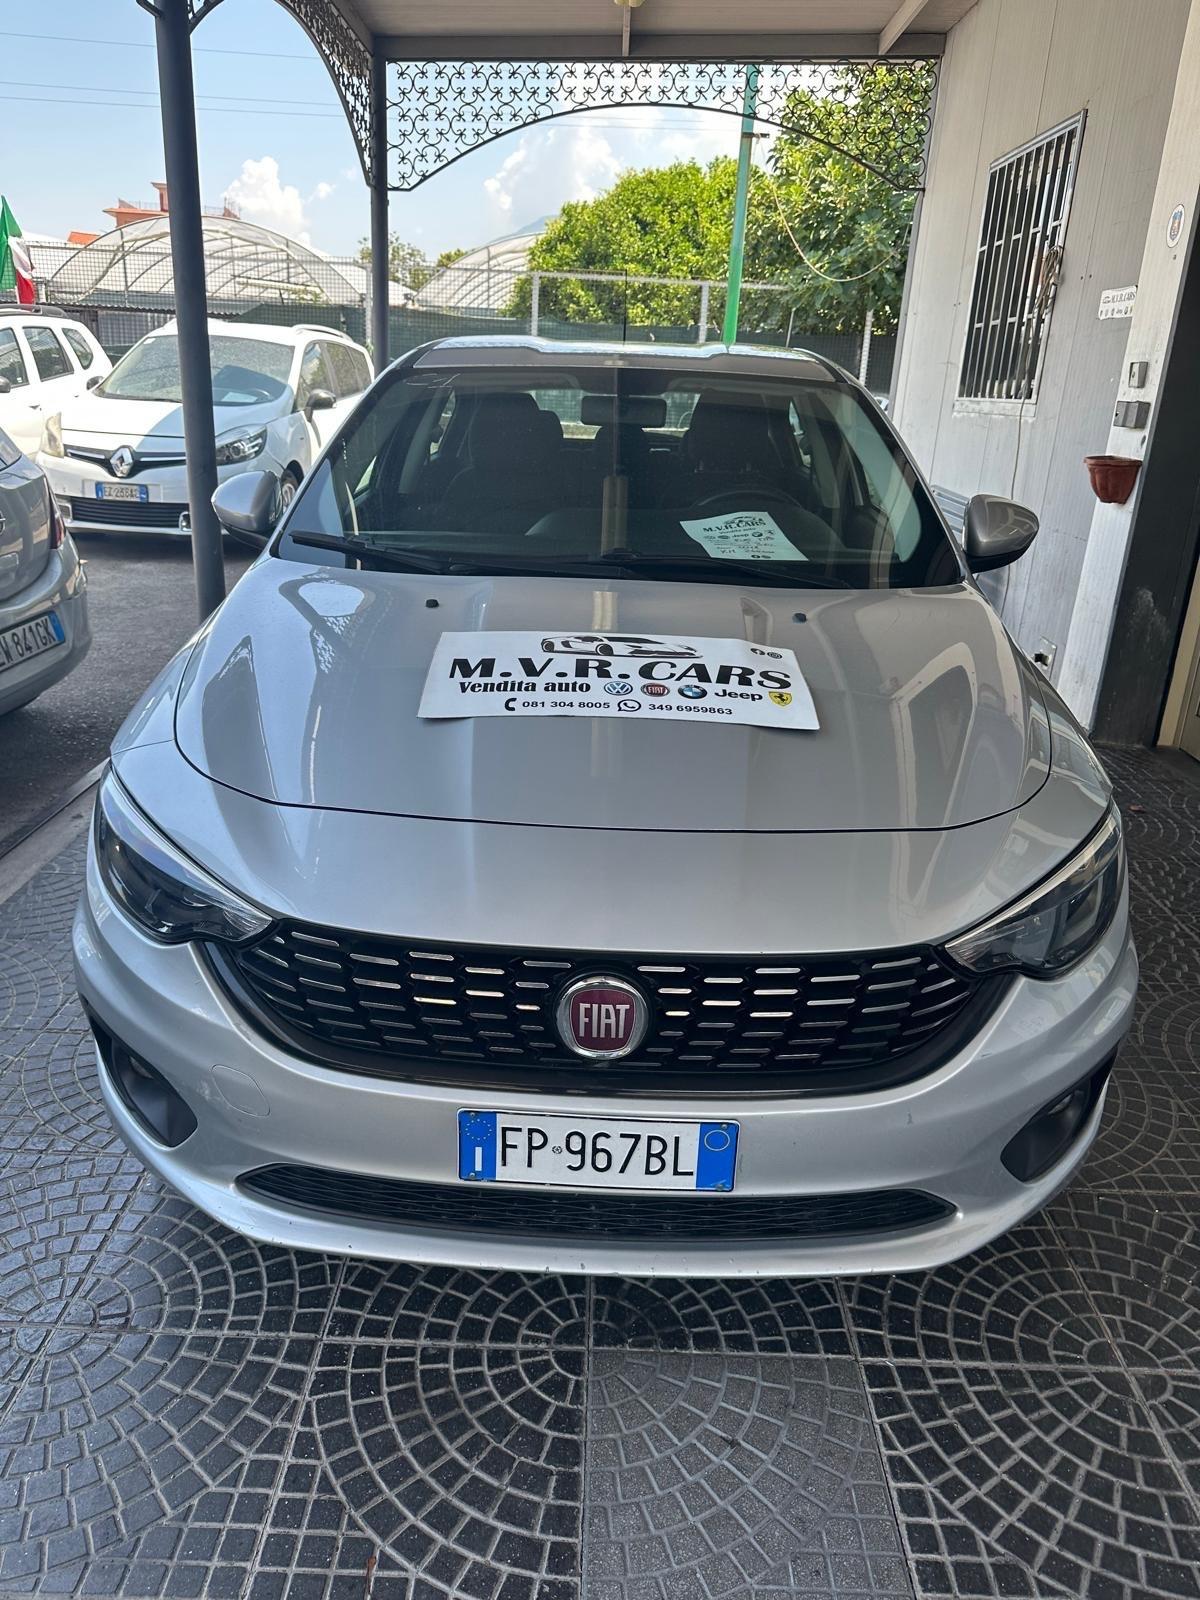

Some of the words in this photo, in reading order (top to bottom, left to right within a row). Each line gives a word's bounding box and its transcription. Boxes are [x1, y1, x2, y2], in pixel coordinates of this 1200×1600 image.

[459, 680, 537, 693] Vendita
[543, 681, 591, 693] auto
[714, 689, 763, 702] Jeep
[578, 701, 610, 709] 8005
[648, 703, 673, 711] 349
[676, 705, 733, 715] 6959863
[578, 1002, 630, 1039] FIAT
[500, 1126, 549, 1169] FP
[564, 1130, 695, 1177] 967BL
